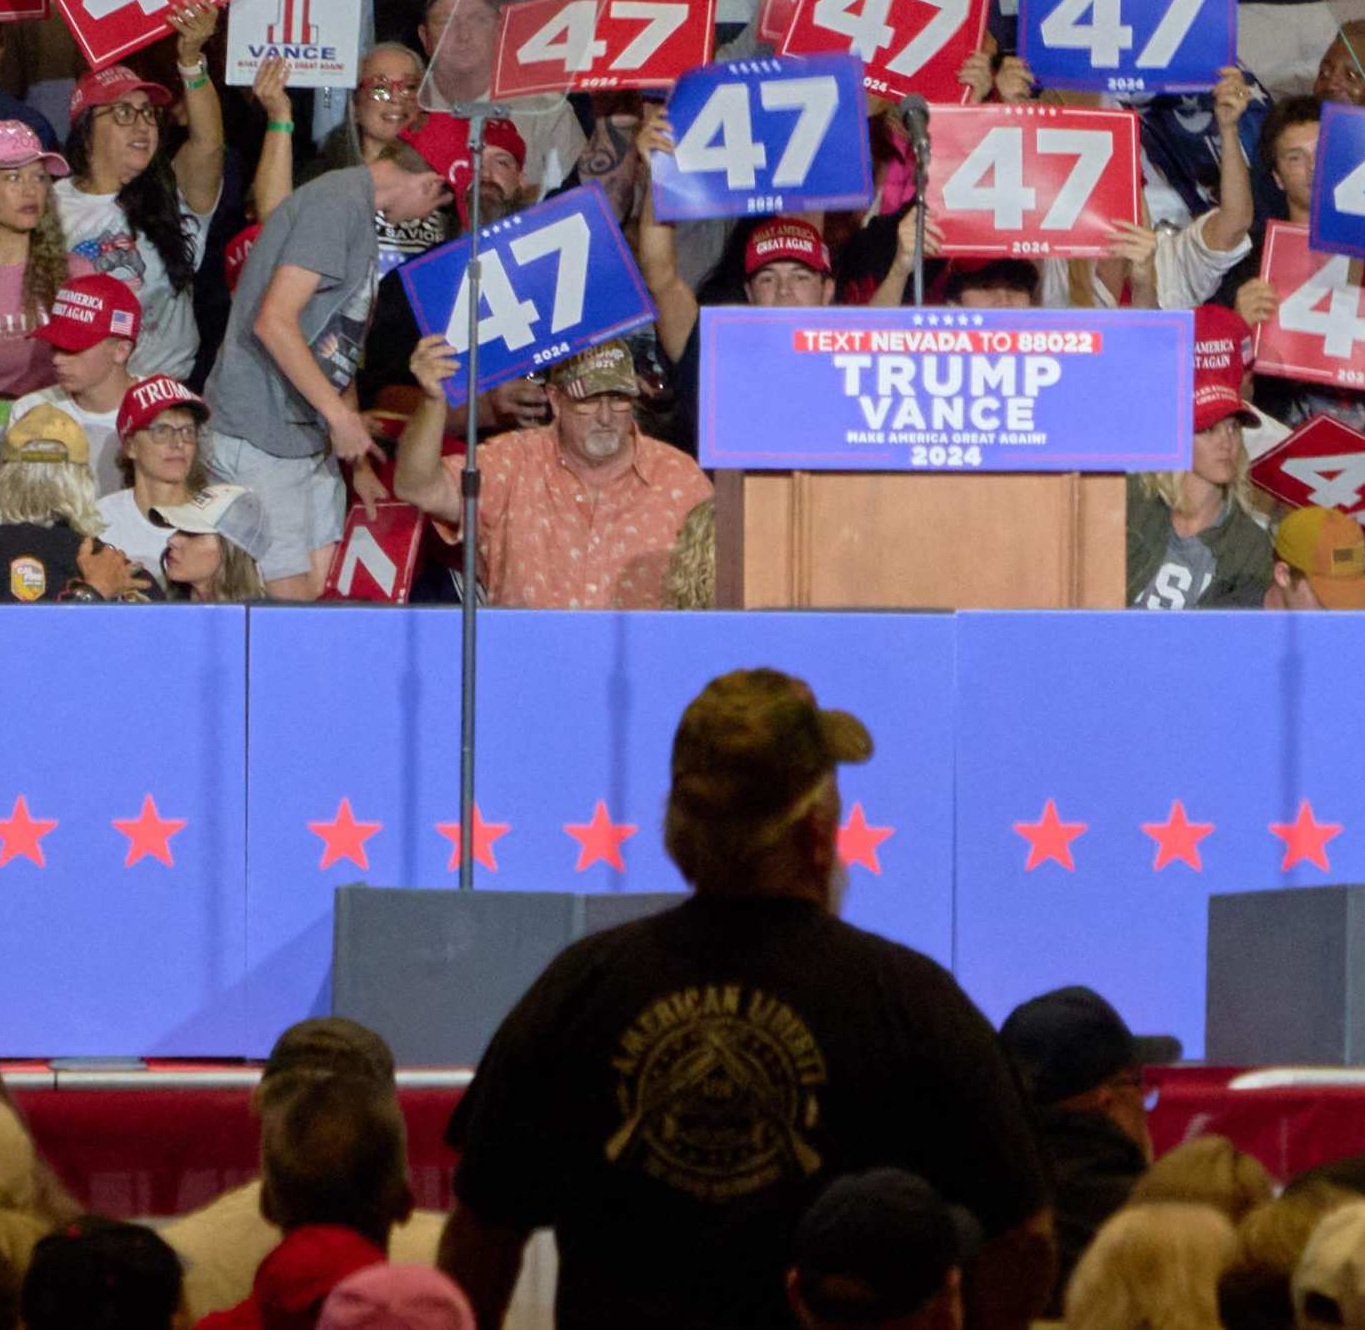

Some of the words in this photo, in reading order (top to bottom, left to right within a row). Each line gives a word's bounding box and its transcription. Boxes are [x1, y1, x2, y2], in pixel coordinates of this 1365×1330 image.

[516, 0, 690, 72] 47
[248, 44, 336, 60] VANCE
[580, 77, 619, 89] 2024
[863, 77, 888, 92] 024
[1108, 78, 1145, 91] 2024
[675, 75, 840, 190] 47
[942, 127, 1113, 231] 47
[756, 239, 783, 255] GREAT
[785, 238, 812, 253] AGAIN
[1013, 242, 1050, 253] 2024
[446, 213, 592, 353] 47
[804, 332, 863, 351] TEXT
[871, 332, 973, 352] NEVADA
[979, 333, 1012, 352] TO
[1018, 332, 1093, 352] 88022
[1194, 339, 1234, 354] AMERICA
[533, 342, 570, 365] 2024
[1203, 355, 1230, 369] AGAIN
[833, 355, 1062, 396] TRUMP
[859, 398, 1035, 430] VANCE
[847, 433, 885, 444] MAKE
[888, 433, 949, 444] AMERICA
[952, 433, 995, 444] GREAT
[999, 433, 1047, 444] AGAIN!
[911, 446, 981, 466] 2024
